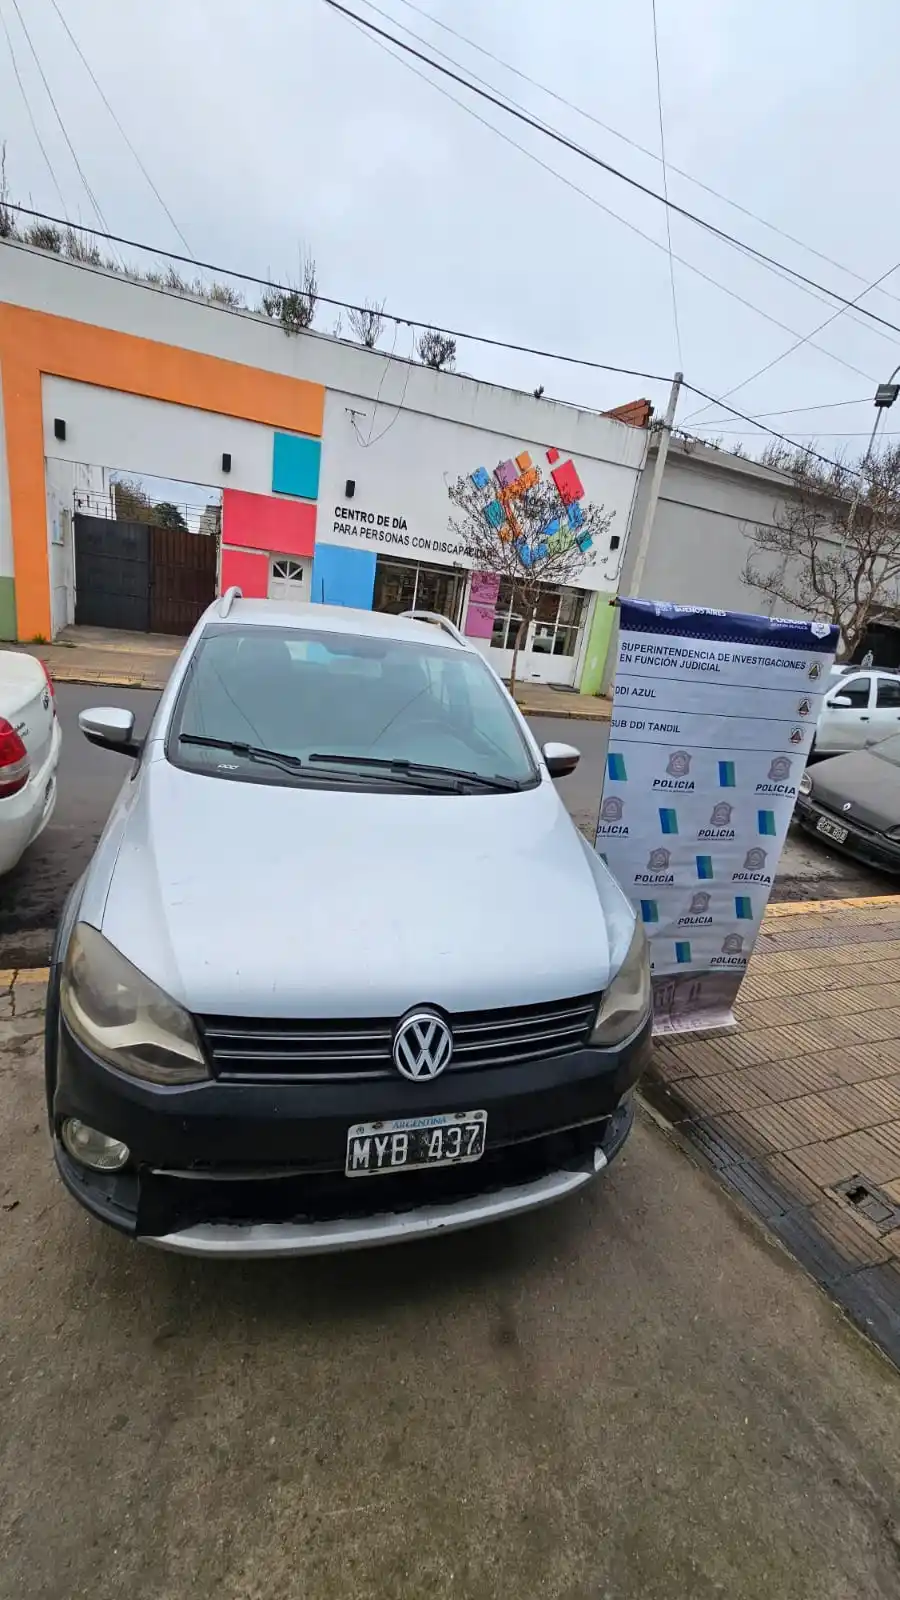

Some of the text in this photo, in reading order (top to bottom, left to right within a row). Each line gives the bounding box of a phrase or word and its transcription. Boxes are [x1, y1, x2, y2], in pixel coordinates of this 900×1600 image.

[334, 506, 408, 530] CENTRO DE DÍA
[333, 522, 358, 534] PARA
[359, 525, 410, 546] PERSONAS
[411, 537, 432, 550] CON
[706, 607, 726, 617] AIRES
[621, 642, 807, 670] SUPERINTENDENCIA DE INVESTIGACIONES
[619, 653, 721, 672] EN FUNCIÓN JUDICIAL
[615, 686, 656, 698] DDI AZUL
[611, 719, 681, 733] SUB DDI TANDIL
[653, 779, 695, 789] POLICIA
[756, 783, 796, 794] POLICIA
[597, 825, 629, 834] OLICIA
[698, 828, 736, 838] POLICIA
[634, 873, 674, 883] POLICIA
[731, 872, 771, 884] POLICIA
[677, 916, 713, 926] POLICIA
[710, 956, 747, 965] POLICIA
[392, 1115, 447, 1129] ARGENTINA
[352, 1125, 481, 1169] MYB 437
